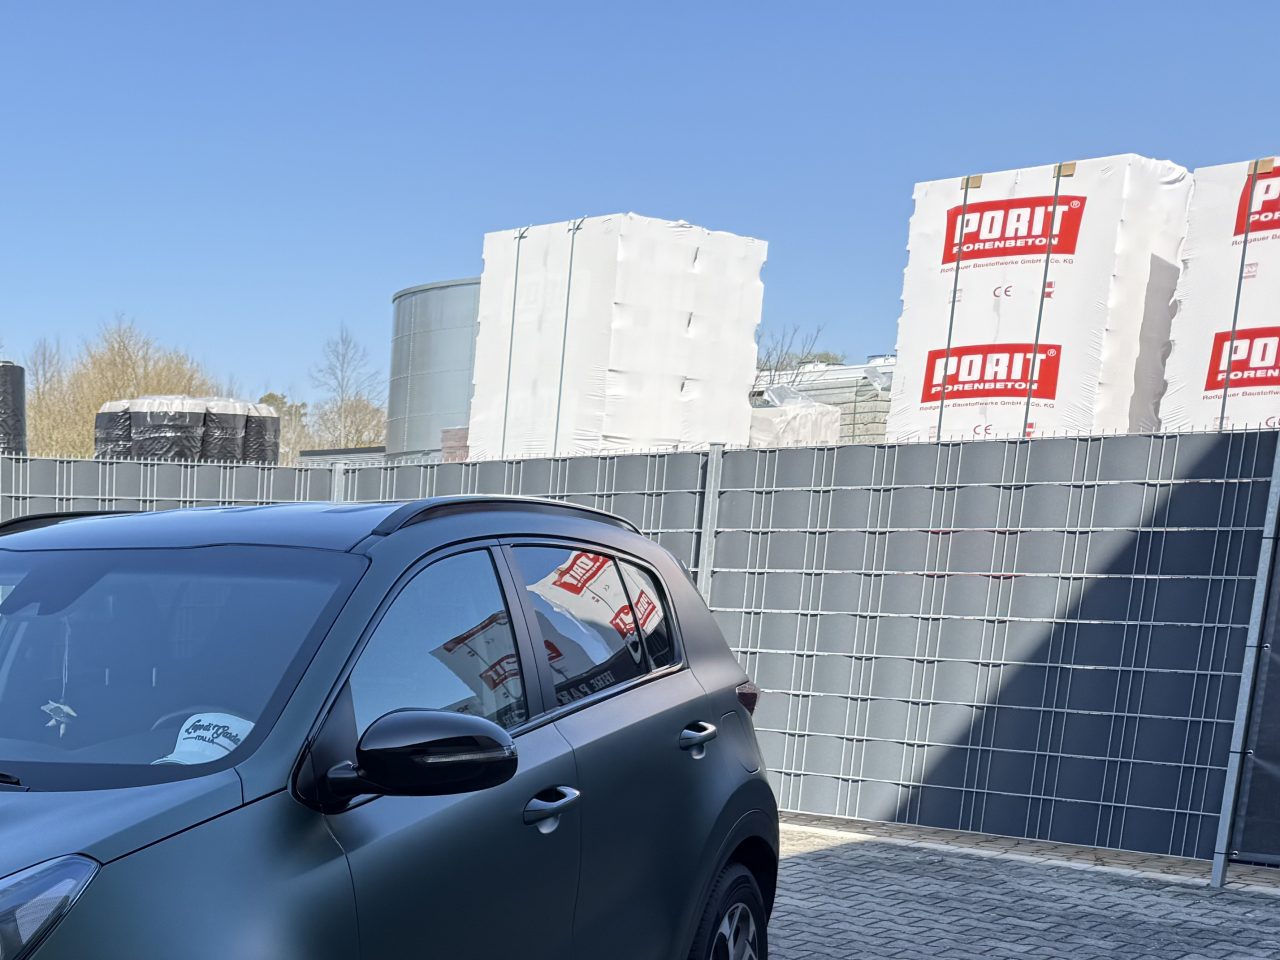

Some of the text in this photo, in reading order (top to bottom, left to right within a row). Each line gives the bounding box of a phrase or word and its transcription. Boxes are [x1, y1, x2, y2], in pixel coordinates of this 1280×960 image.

[952, 236, 1059, 254] PORENBETON
[931, 381, 1039, 394] PORENBETON
[194, 734, 216, 745] ITALIA
